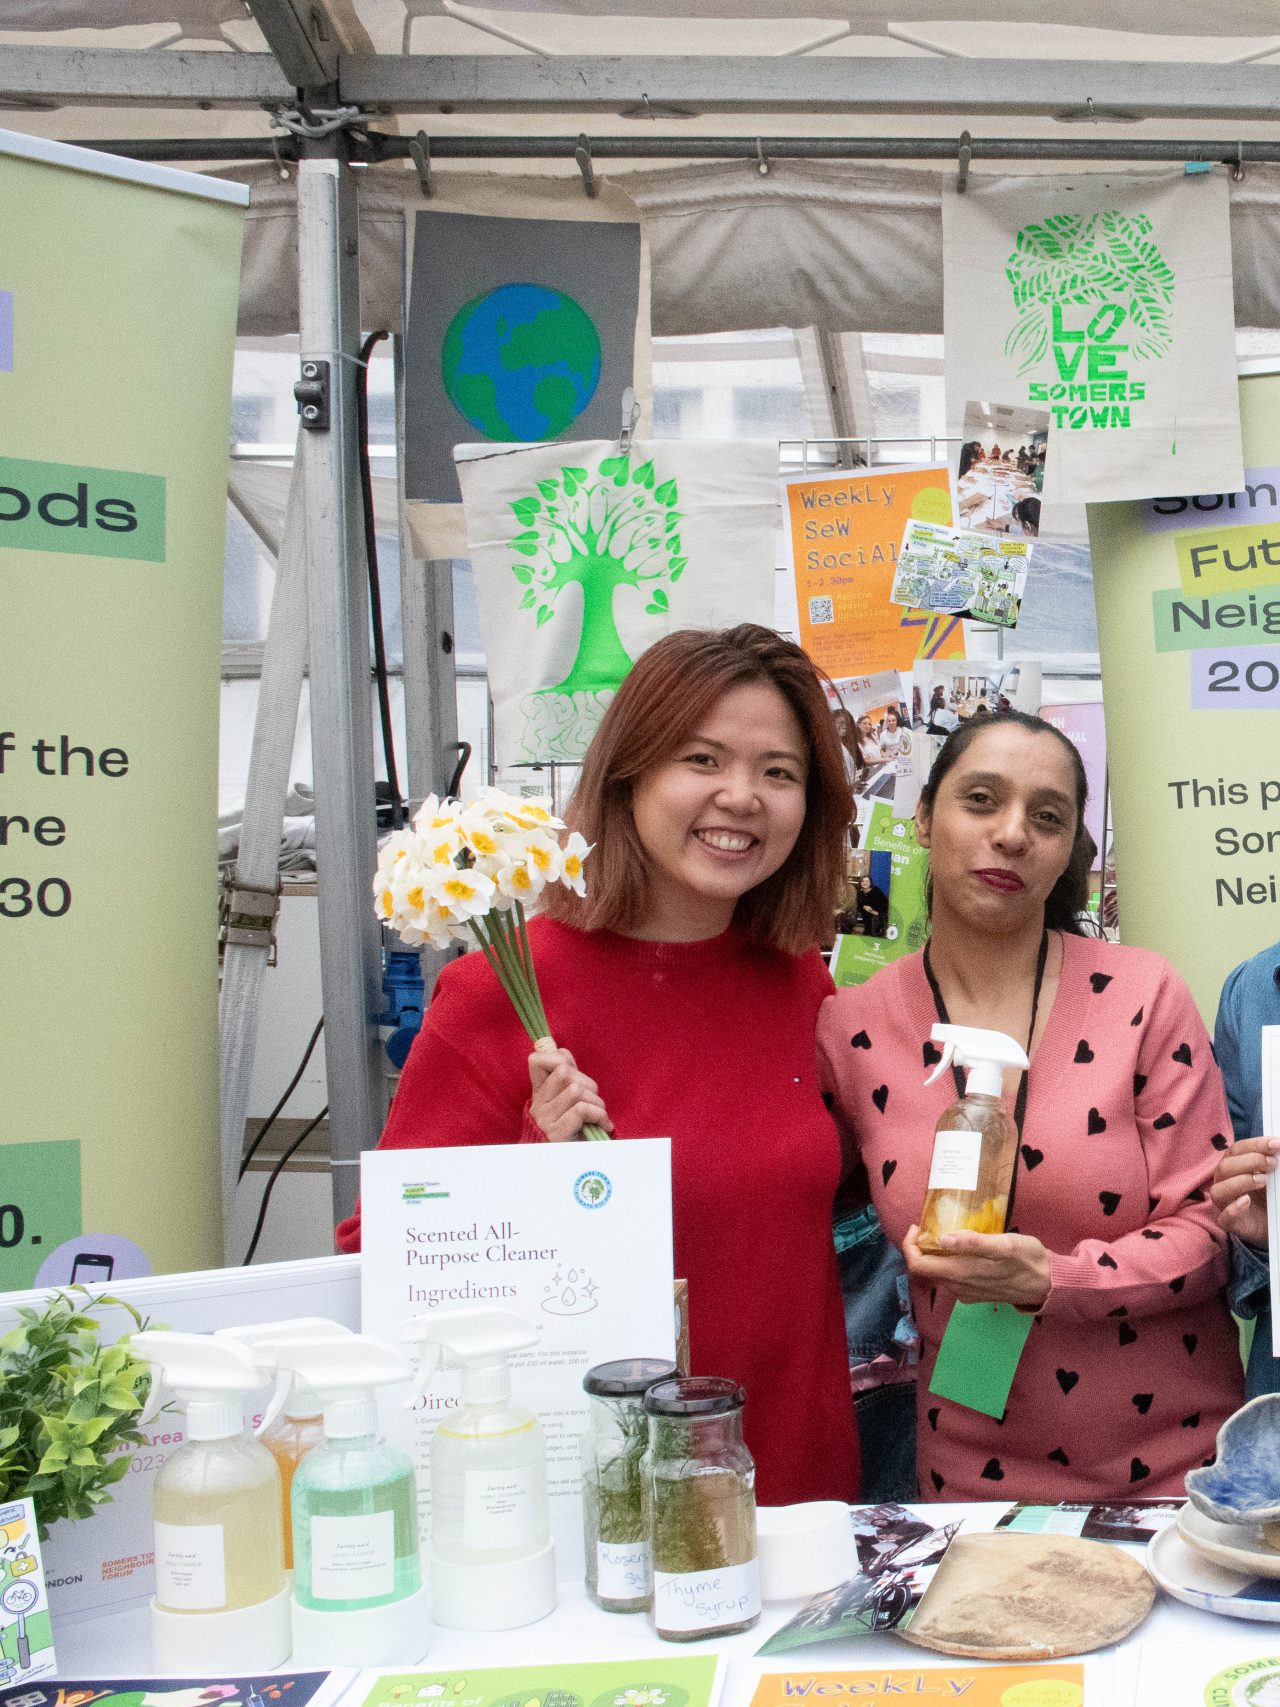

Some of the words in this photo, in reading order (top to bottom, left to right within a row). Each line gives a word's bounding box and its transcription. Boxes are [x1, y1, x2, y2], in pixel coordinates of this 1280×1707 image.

[1028, 382, 1146, 401] SOMERS
[1051, 405, 1131, 429] TOWN
[32, 735, 129, 777] the
[1168, 777, 1249, 809] This
[891, 855, 910, 865] an
[406, 1223, 478, 1244] Scented
[484, 1222, 520, 1241] All-
[406, 1247, 480, 1271] Purpose
[486, 1244, 558, 1262] Cleaner
[407, 1280, 517, 1307] Ingredients
[102, 1556, 138, 1569] SOMERS
[140, 1551, 155, 1561] TO
[45, 1574, 83, 1588] NDON
[102, 1569, 133, 1581] FORUM
[659, 1576, 723, 1606] Thyme
